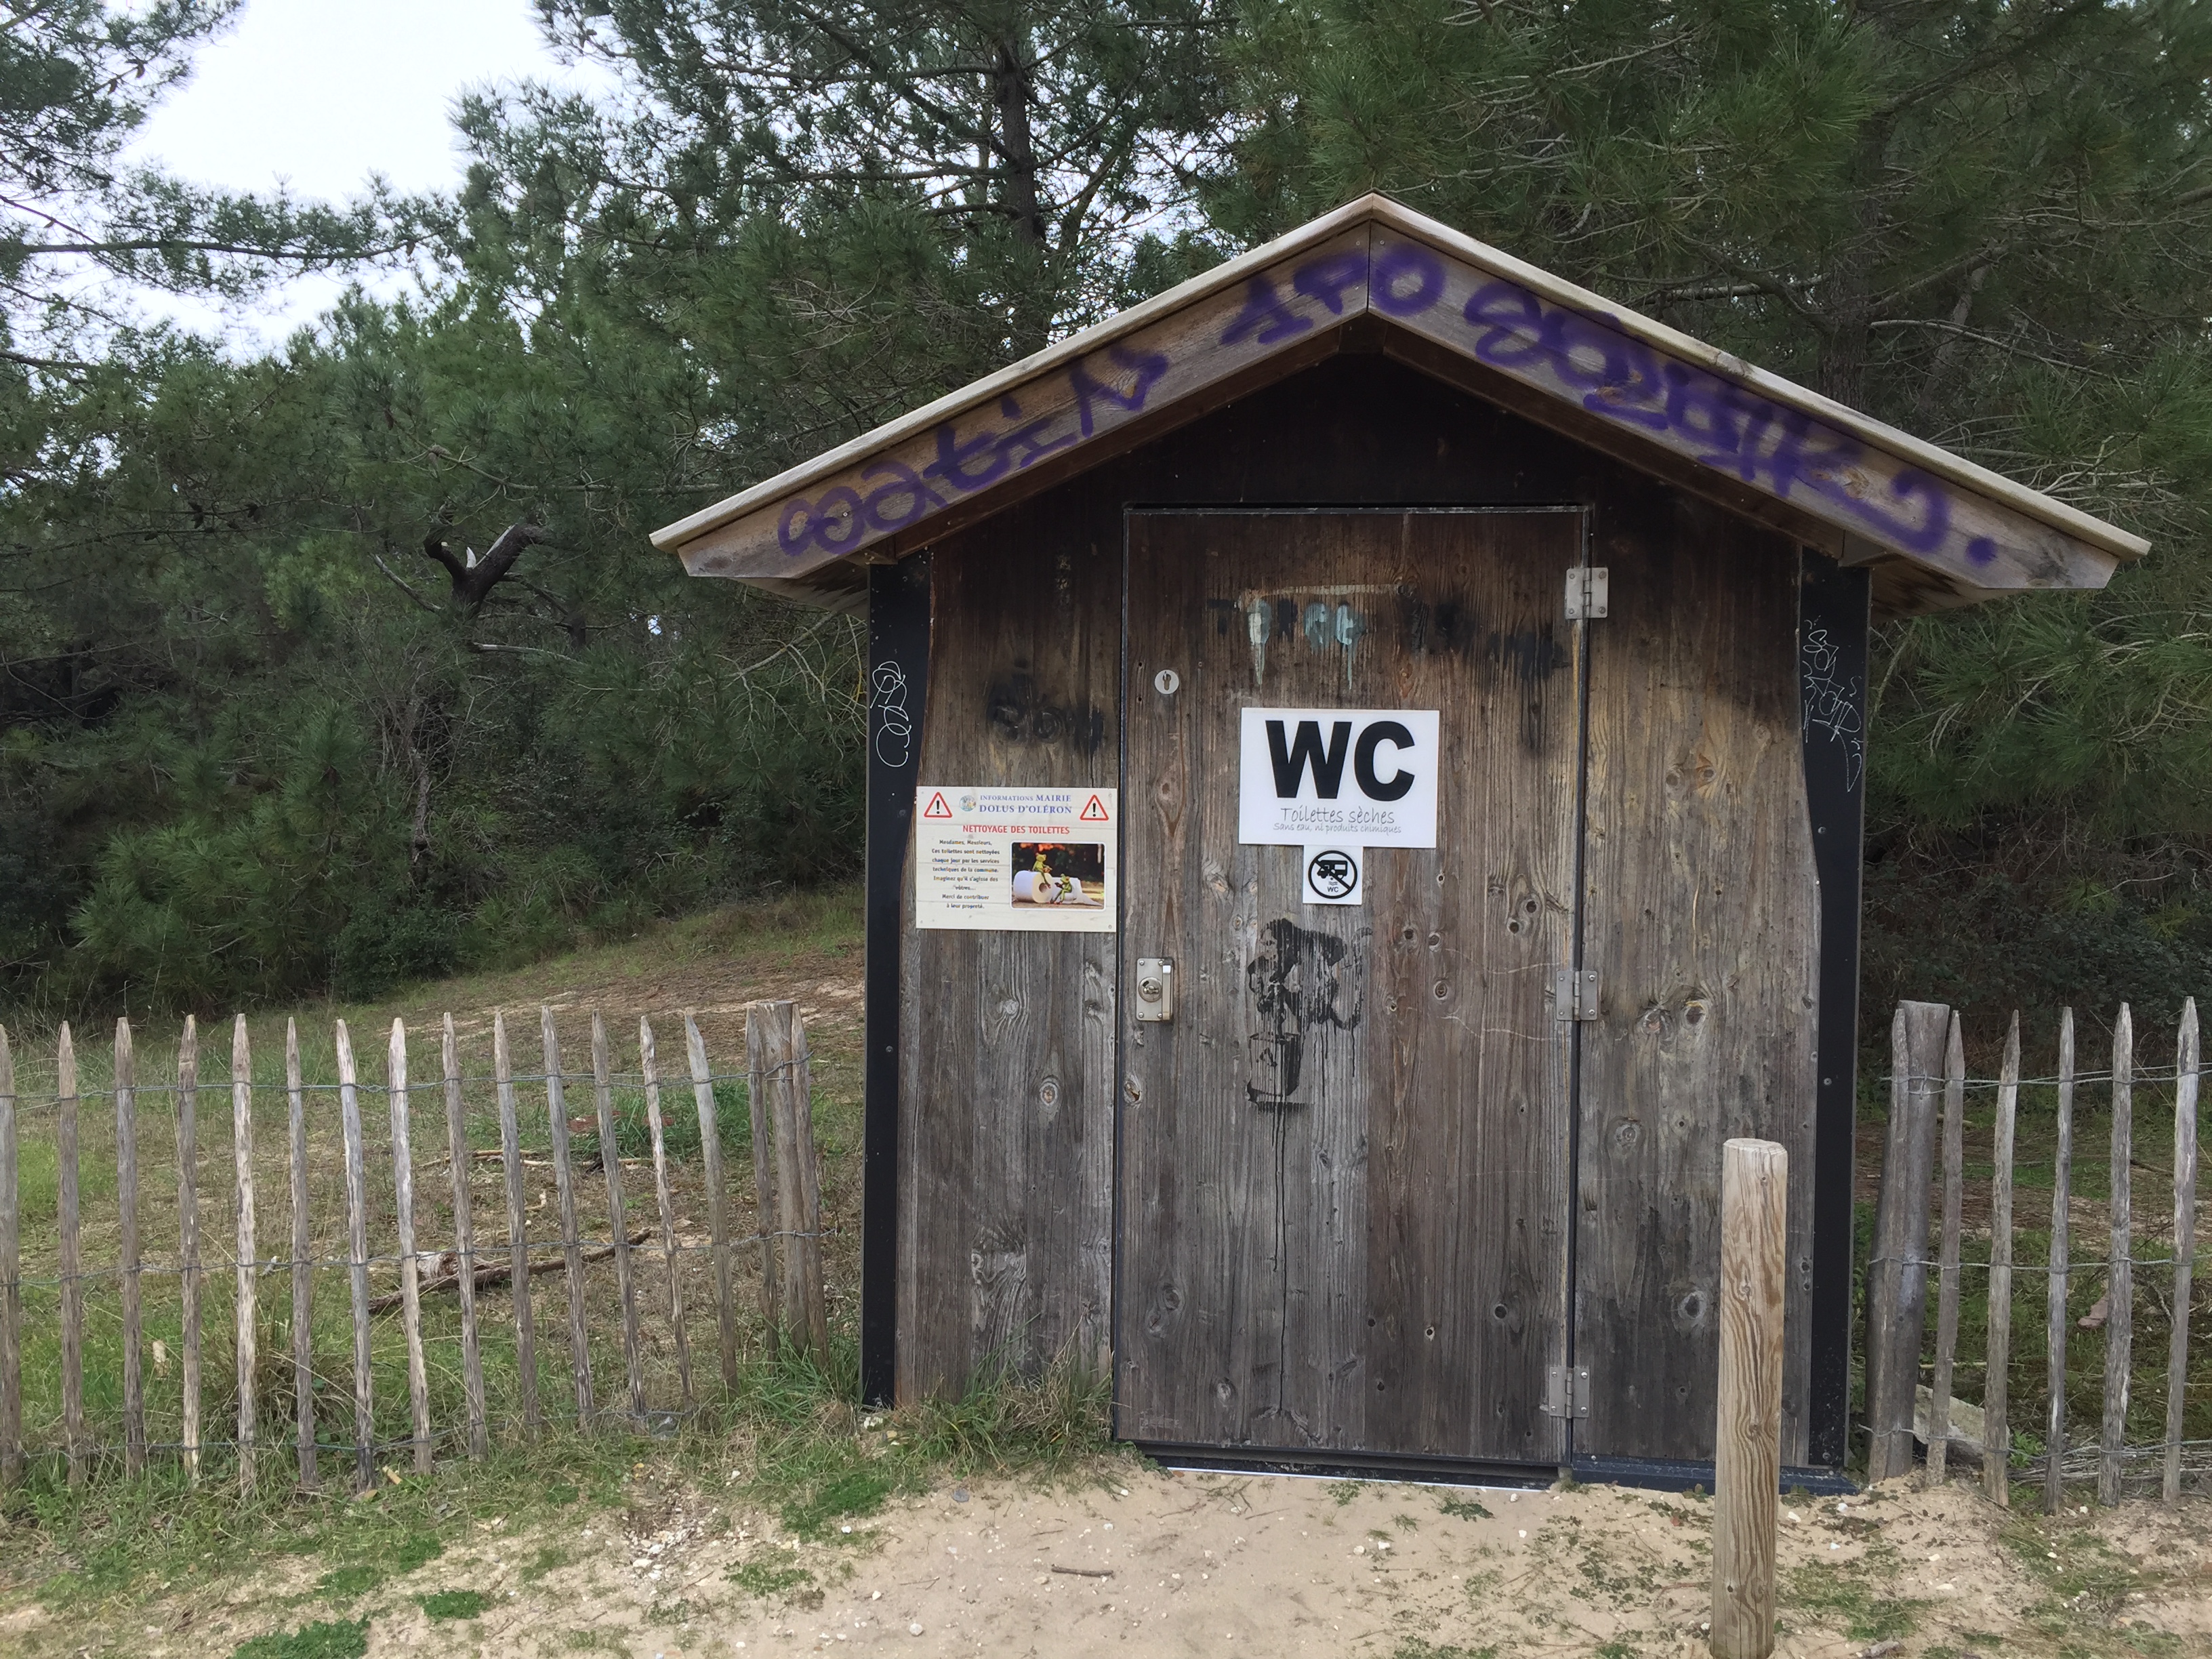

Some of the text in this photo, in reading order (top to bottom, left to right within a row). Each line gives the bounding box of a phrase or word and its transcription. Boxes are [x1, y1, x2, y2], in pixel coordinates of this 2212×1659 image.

[1265, 720, 1416, 802] WC
[1036, 794, 1071, 802] MAIRIE
[979, 804, 1072, 813] DOLUS D'OLÉRON
[1281, 804, 1395, 824] Toilettes sèches
[963, 825, 1070, 834] NETTOYAGE DES TOILETTES
[1273, 822, 1401, 836] Sans eau, ni produits chimiques
